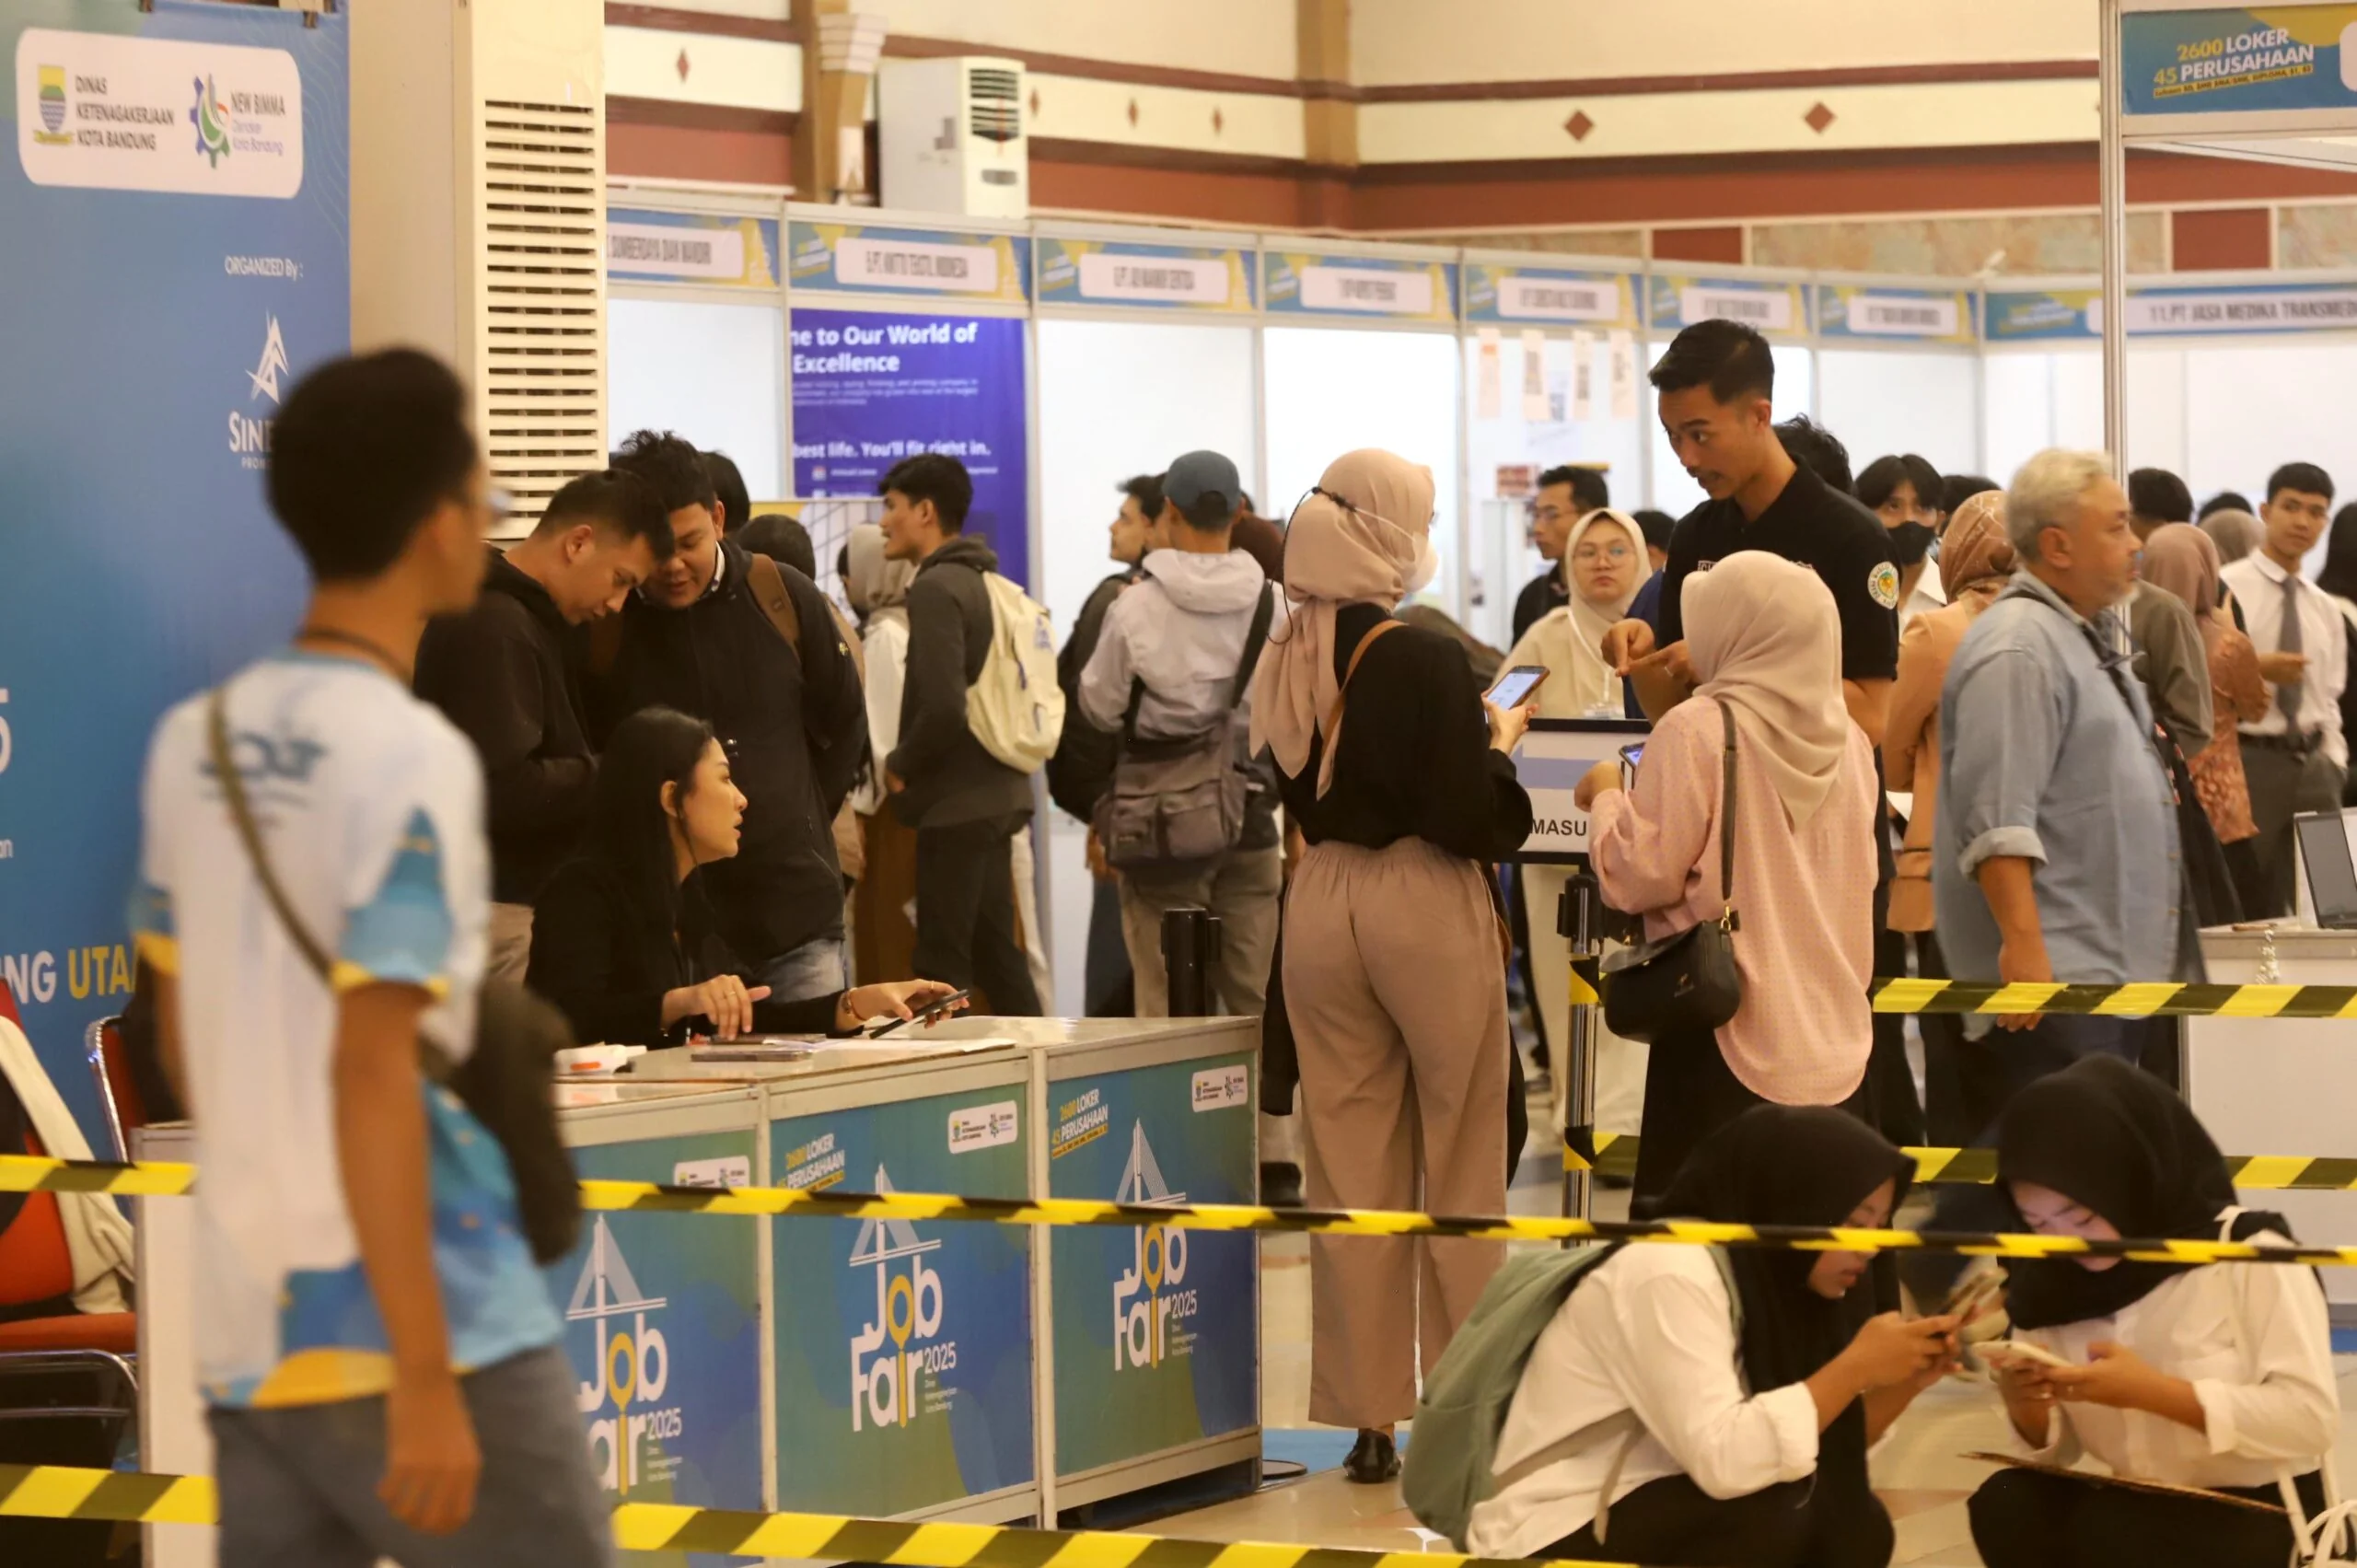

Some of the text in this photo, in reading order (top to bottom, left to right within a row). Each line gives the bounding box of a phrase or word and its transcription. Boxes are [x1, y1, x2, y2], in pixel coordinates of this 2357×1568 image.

[2177, 28, 2290, 62] 2600 LOKER
[2154, 44, 2315, 85] 45 PERUSAHAAN
[75, 75, 108, 95] DINAS
[75, 102, 175, 127] KETENAGAKERJAAN
[230, 92, 253, 113] NEW
[76, 129, 157, 152] KOTA BANDUNG
[224, 255, 284, 277] ORGANIZED
[816, 328, 840, 346] to
[842, 325, 884, 345] Our
[886, 322, 951, 345] World
[953, 321, 979, 343] of
[793, 352, 900, 374] Excellence
[793, 442, 826, 459] best
[1531, 819, 1587, 837] MASU
[0, 944, 138, 1005] NG UTA
[1076, 1088, 1100, 1114] LOKER
[1062, 1103, 1109, 1143] PERUSAHAAN
[807, 1132, 834, 1161] LOKER
[787, 1149, 845, 1190] PERUSAHAAN
[1123, 1224, 1188, 1296] Job
[863, 1253, 943, 1350] Job
[1113, 1280, 1172, 1372] Fair
[1171, 1289, 1198, 1319] 2025
[576, 1311, 668, 1413] Job
[850, 1335, 923, 1433] Fair
[923, 1341, 958, 1375] 2025
[586, 1412, 645, 1496] air
[646, 1407, 683, 1441] 2025
